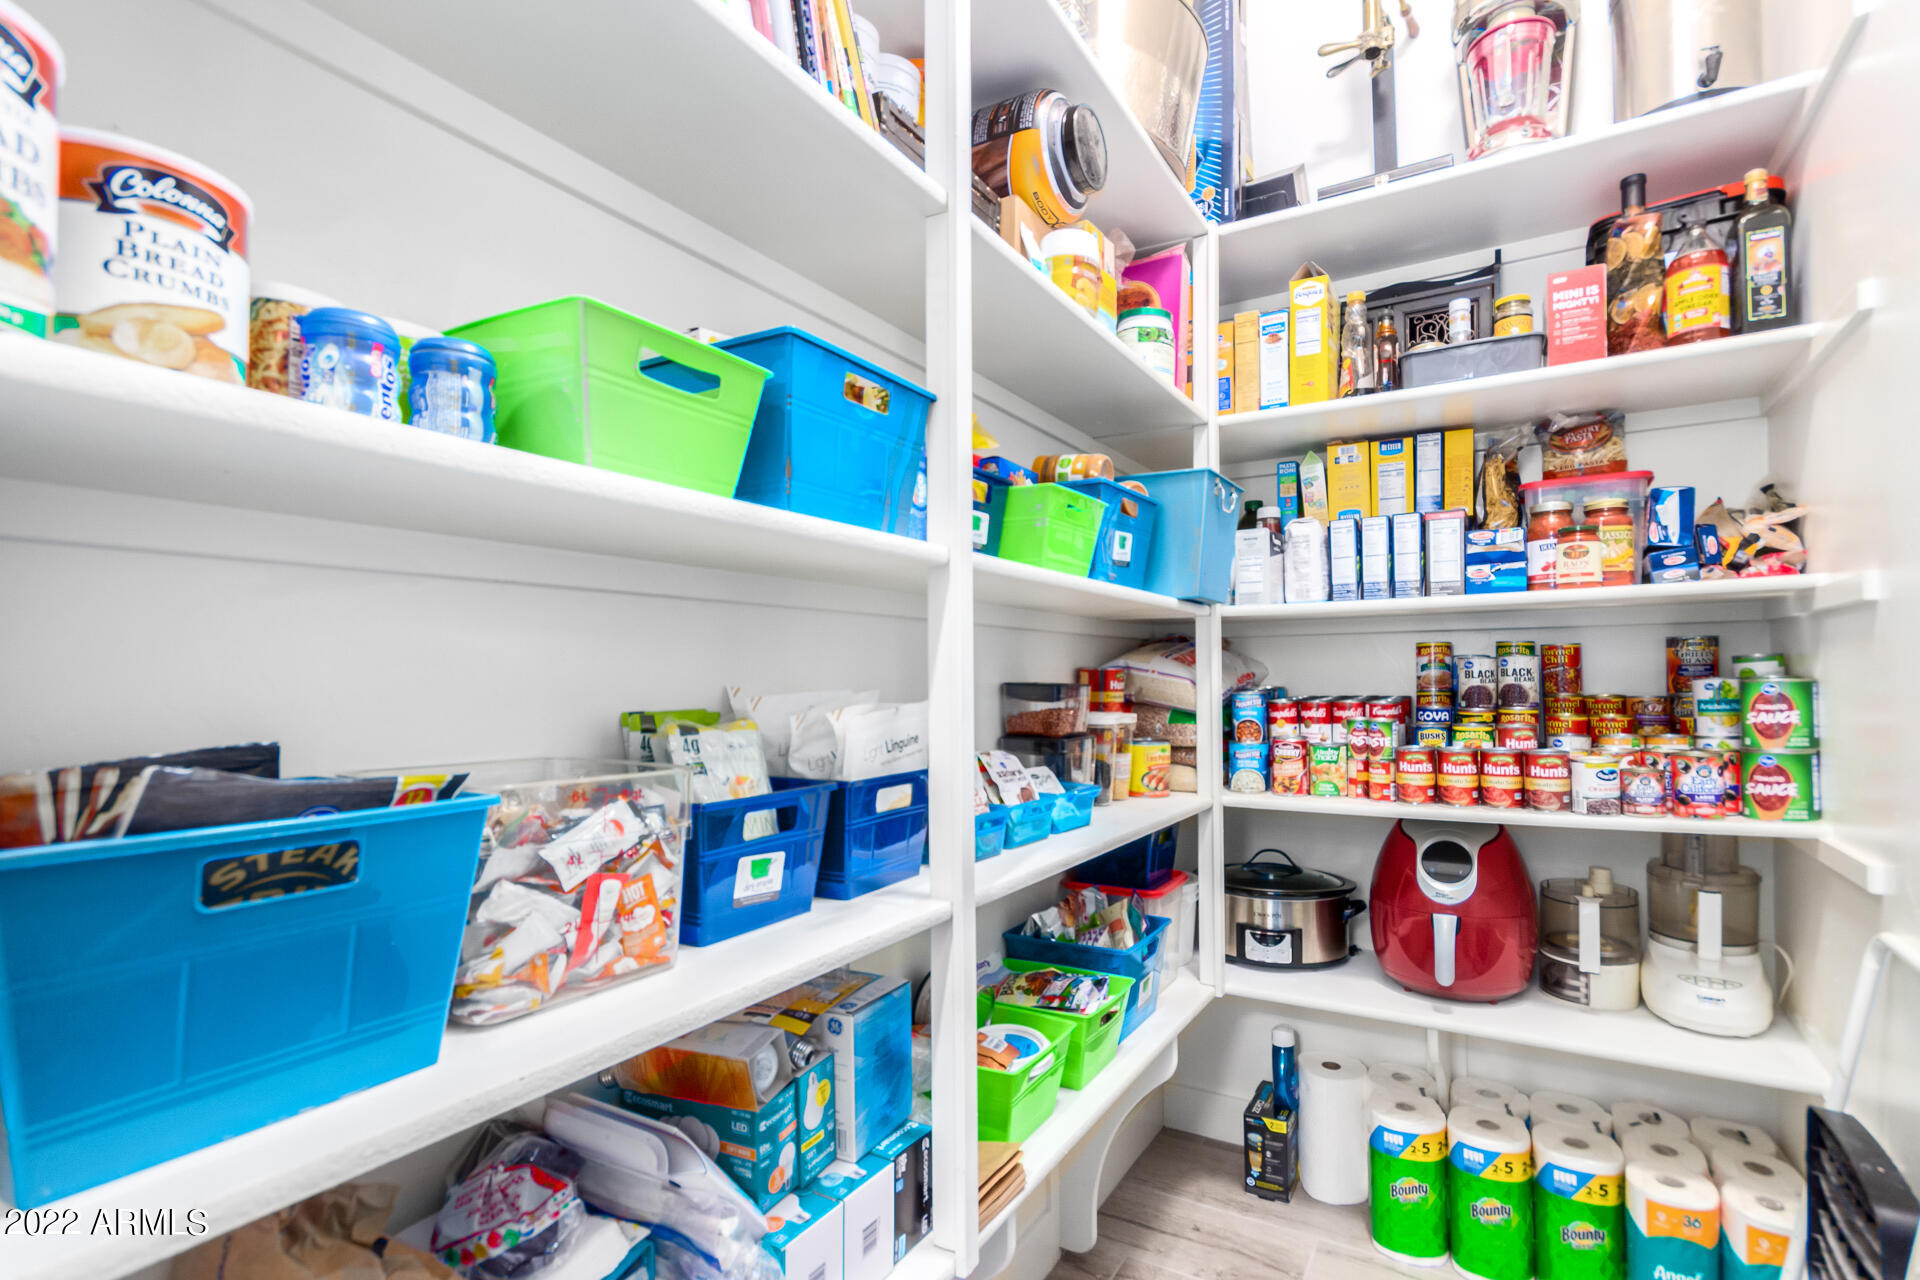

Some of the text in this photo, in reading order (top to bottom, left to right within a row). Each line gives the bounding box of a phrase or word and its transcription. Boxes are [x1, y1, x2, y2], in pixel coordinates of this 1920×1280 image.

[109, 168, 226, 229] Colonna
[1032, 192, 1055, 221] BODY
[123, 220, 222, 267] PLAIN
[116, 238, 225, 290] BREAD
[102, 258, 231, 313] CRUMBS
[1552, 284, 1600, 302] MINI IS
[1552, 295, 1600, 311] MIGHTY!
[380, 359, 397, 420] entos
[1565, 433, 1594, 444] PASTA
[1544, 655, 1568, 664] Chili
[1465, 669, 1495, 679] BLACK
[1500, 667, 1533, 677] BLACK
[1418, 711, 1449, 721] GOYA
[1501, 713, 1536, 724] Rosarita
[1746, 710, 1801, 725] SAUCE
[1591, 719, 1628, 729] Hormel
[884, 733, 920, 754] Linguine
[1420, 732, 1446, 741] BUSH'S
[1455, 731, 1490, 741] Rosarita
[1692, 775, 1717, 786] Early
[1745, 783, 1798, 797] SAUCE
[208, 843, 360, 892] STEAK
[622, 881, 646, 905] HOT
[731, 1121, 749, 1133] LED
[1410, 1142, 1431, 1155] 2 5
[1492, 1161, 1513, 1175] 2 5
[1389, 1182, 1429, 1199] Bounty
[1585, 1184, 1609, 1198] 2 5
[1470, 1203, 1512, 1219] Bounty
[1682, 1214, 1703, 1230] 36
[1561, 1226, 1606, 1244] Bounty
